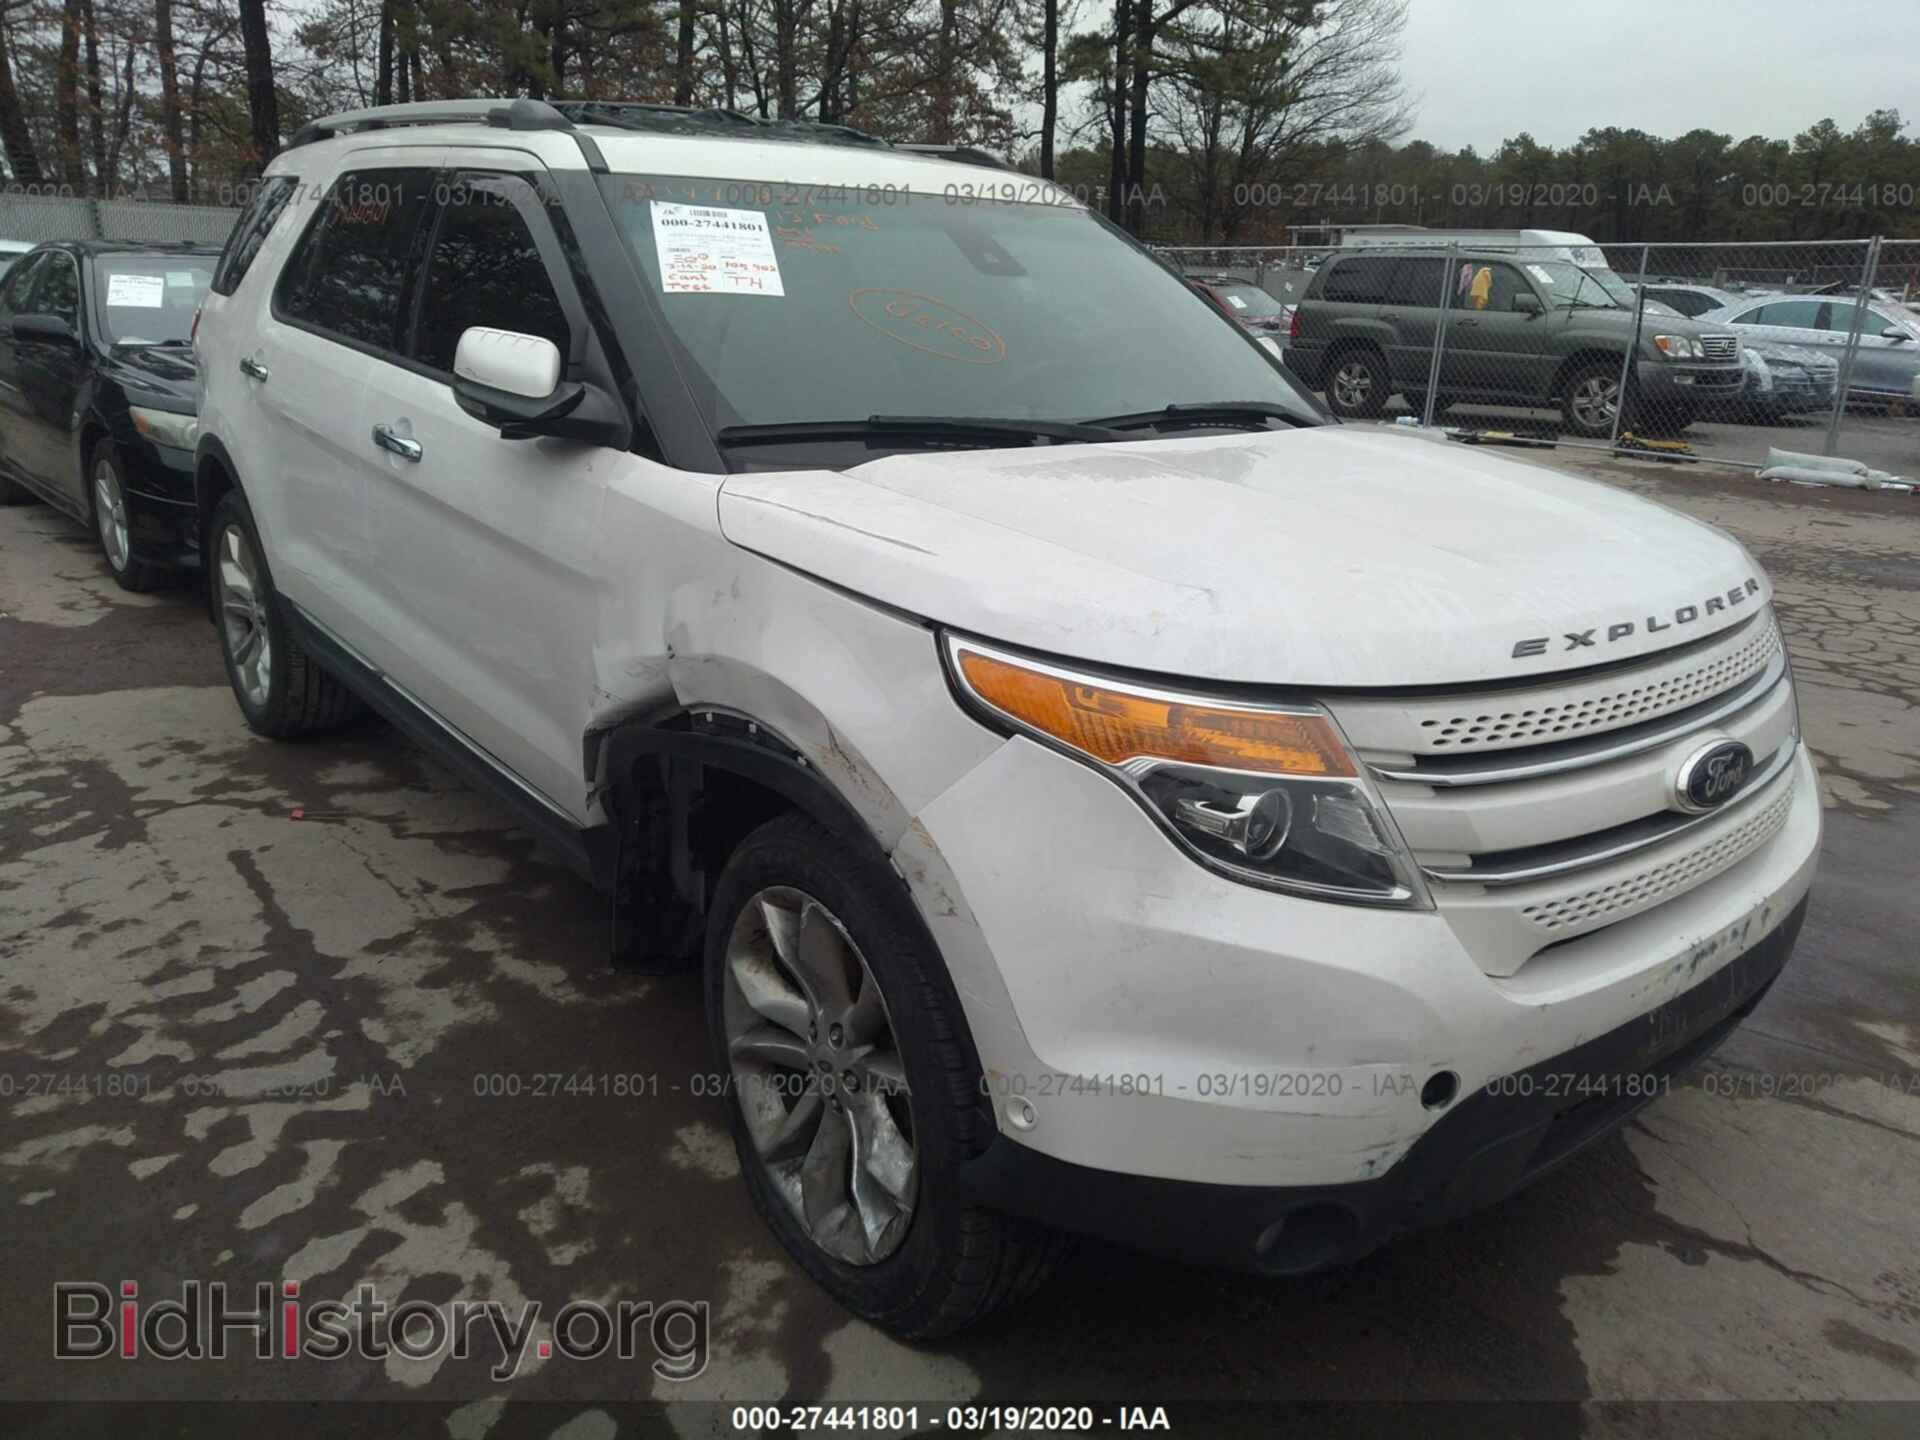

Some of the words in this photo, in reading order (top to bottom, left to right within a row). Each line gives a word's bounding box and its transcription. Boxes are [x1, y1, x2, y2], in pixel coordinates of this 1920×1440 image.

[661, 218, 764, 231] 000-27441801
[1511, 577, 1760, 658] EXPLORER
[1704, 751, 1745, 798] Ford
